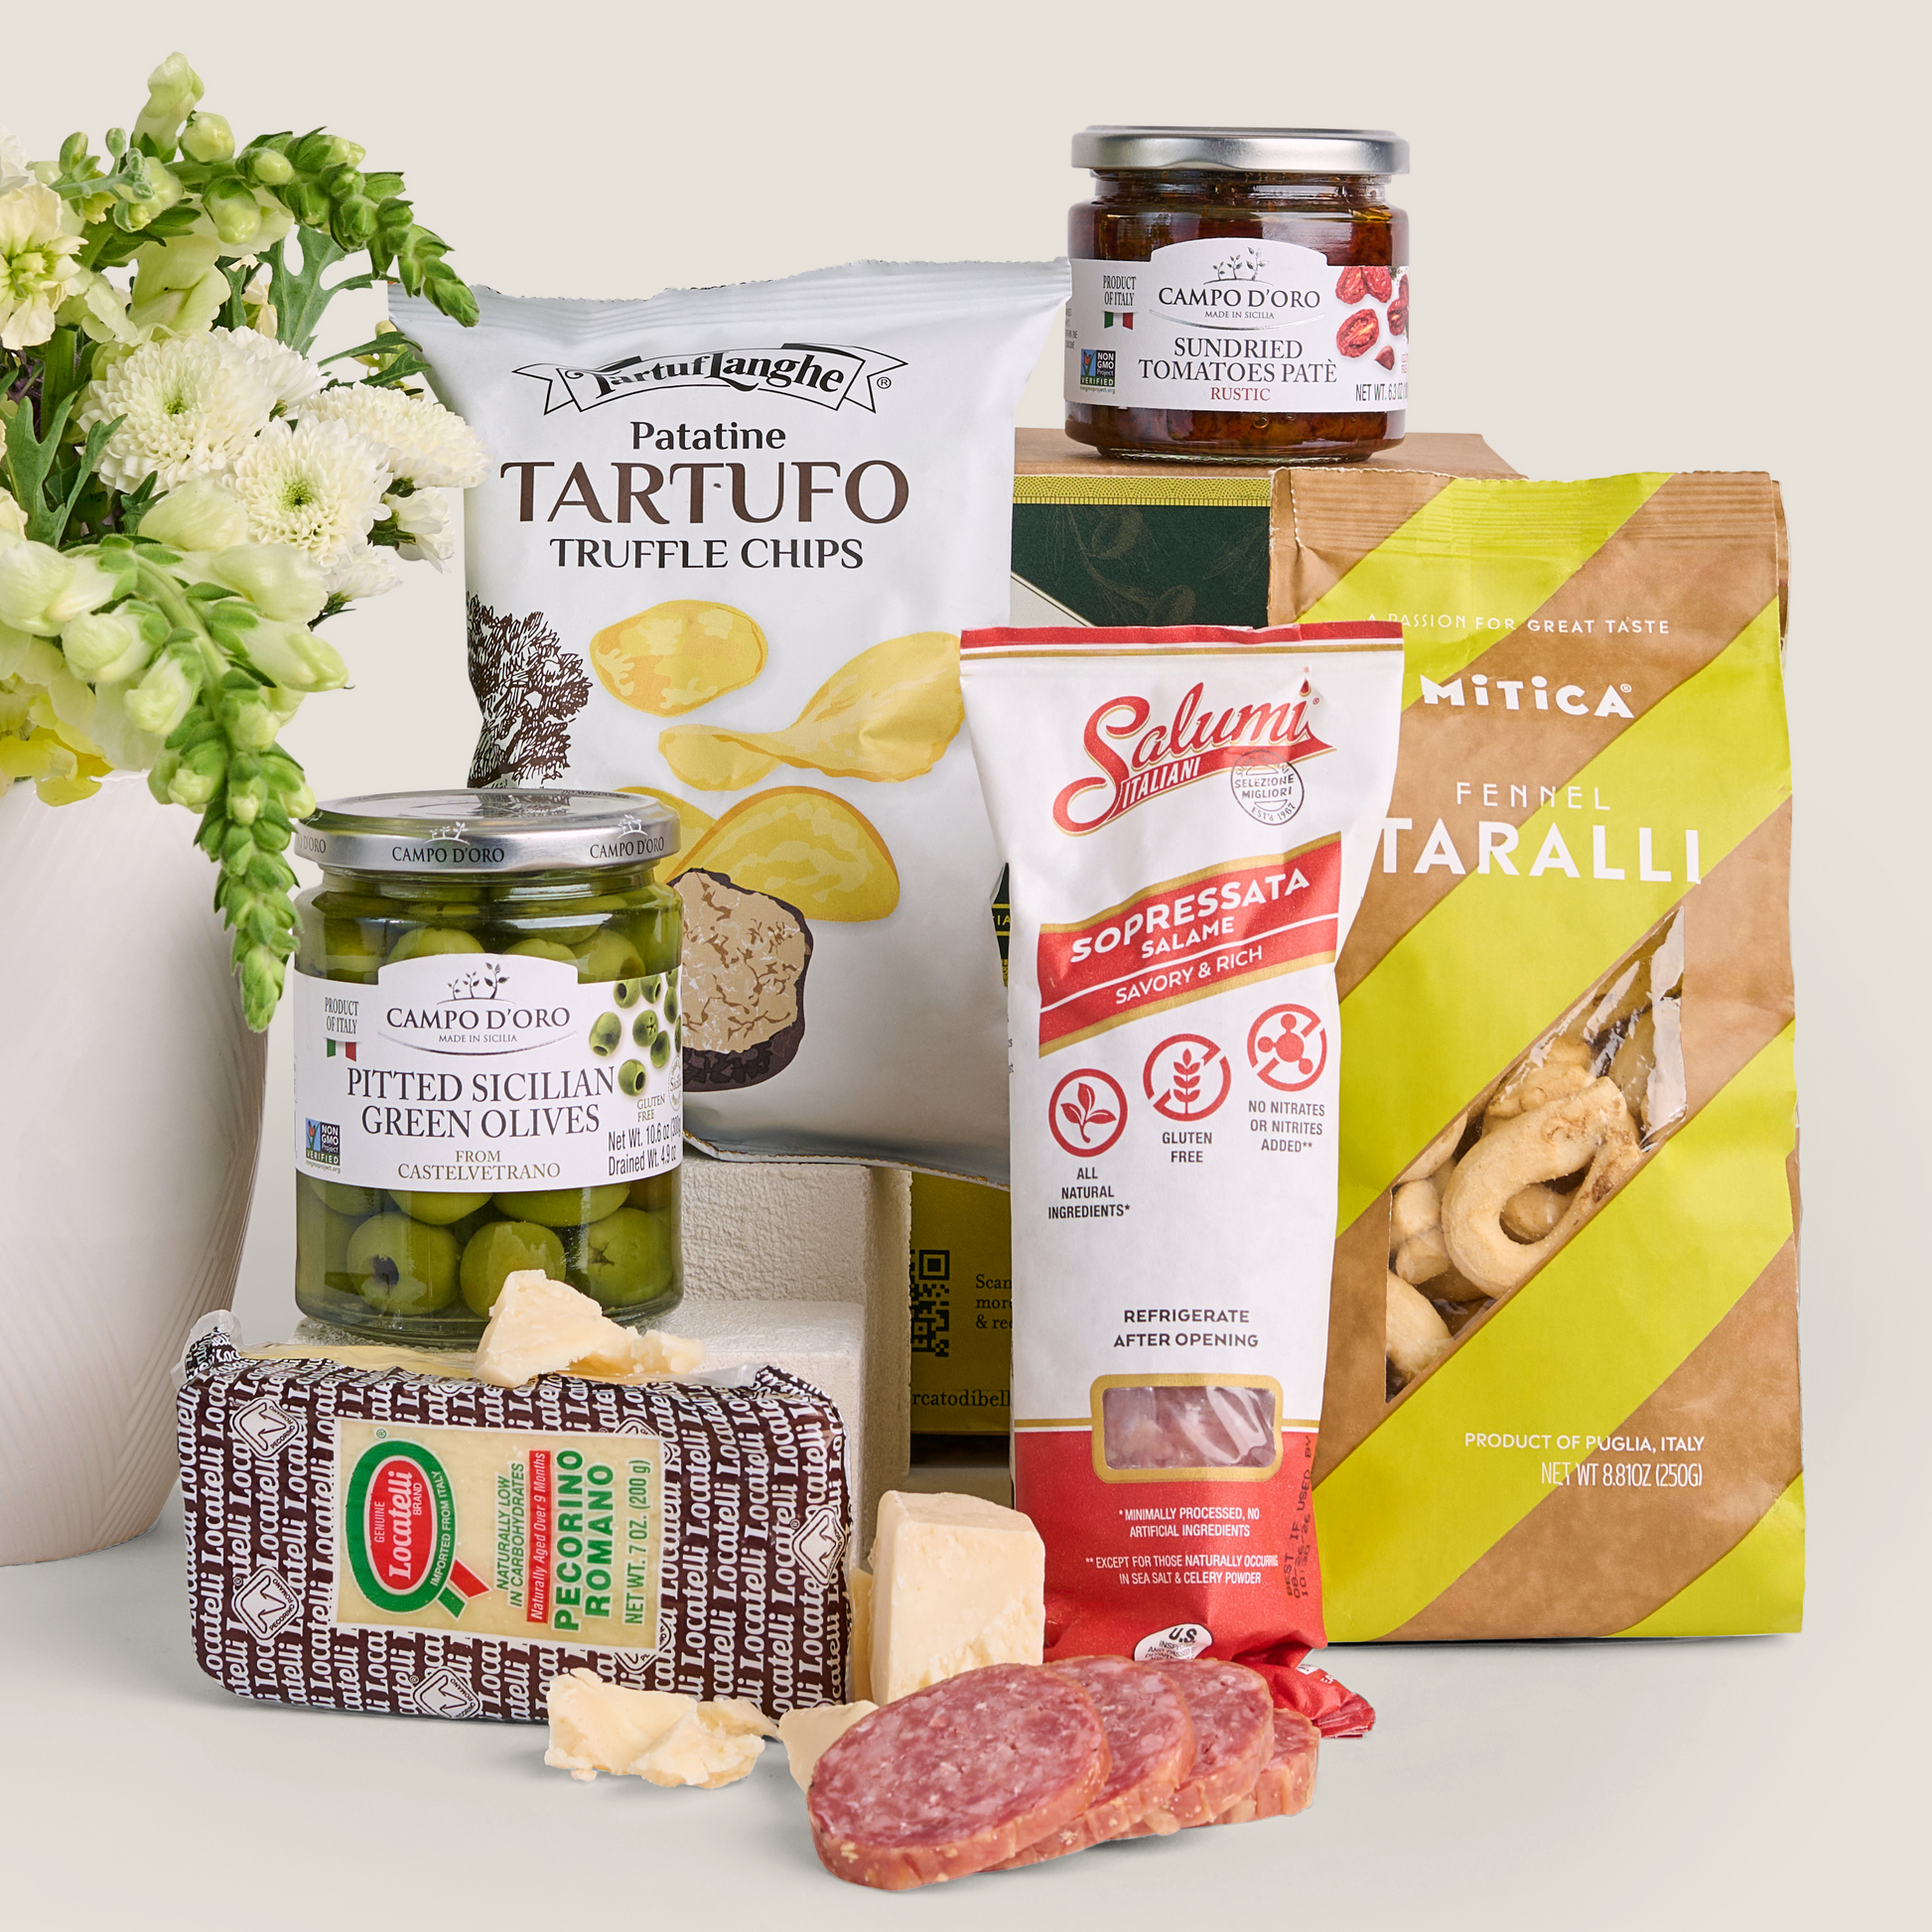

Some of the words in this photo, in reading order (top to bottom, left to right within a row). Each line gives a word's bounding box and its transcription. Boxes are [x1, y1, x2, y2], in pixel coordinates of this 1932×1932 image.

[1103, 275, 1136, 290] PRODUCT
[1104, 292, 1114, 305] OF
[1115, 293, 1134, 306] ITALY
[1159, 287, 1245, 308] CAMPO
[1248, 289, 1320, 309] D'ORO
[1174, 338, 1303, 358] SUNDRIED
[564, 350, 845, 400] TartufLanghe
[1081, 376, 1114, 386] VERIFIED
[1139, 359, 1279, 382] TOMATOES
[1281, 359, 1337, 383] PATÈ
[1210, 387, 1271, 401] RUSTIC
[1356, 383, 1372, 401] NET
[1374, 383, 1387, 401] WT.
[630, 421, 786, 450] Patatine
[499, 460, 909, 525] TARTUFO
[549, 538, 729, 569] TRUFFLE
[741, 537, 864, 570] CHIPS
[1389, 613, 1465, 628] PASSION
[1475, 617, 1517, 630] FOR
[1527, 619, 1595, 634] GREAT
[1605, 620, 1670, 635] TASTE
[1052, 679, 1336, 836] Salumi
[1121, 758, 1201, 809] ITALIANI
[1234, 773, 1295, 788] SELEZIONE
[1242, 786, 1292, 799] MIGLIORI
[1456, 781, 1611, 810] FENNEL
[1277, 802, 1296, 820] 1967
[303, 835, 327, 854] D'ORO
[392, 846, 447, 864] CAMPO
[453, 847, 504, 864] D'ORO
[590, 843, 634, 860] CAMPO
[636, 837, 664, 856] D'ORO
[1382, 817, 1701, 884] TARALLI
[1069, 868, 1310, 964] SOPRESSATA
[1142, 915, 1234, 959] SALAME
[1116, 967, 1193, 1005] SAVORY
[1197, 962, 1211, 977] &
[1217, 945, 1263, 972] RICH
[325, 997, 359, 1017] PRODUCT
[386, 1008, 480, 1031] CAMPO
[485, 1007, 571, 1030] D'ORO
[326, 1015, 337, 1031] OF
[337, 1017, 357, 1035] ITALY
[439, 1035, 466, 1043] MADE
[469, 1035, 480, 1043] IN
[483, 1034, 517, 1043] SICILIA
[347, 1067, 463, 1102] PITTED
[472, 1065, 616, 1103] SICILIAN
[637, 1094, 665, 1110] GLUTEN
[1248, 1100, 1266, 1114] NO
[1270, 1101, 1325, 1117] NITRATES
[361, 1105, 472, 1139] GREEN
[481, 1103, 600, 1139] OLIVES
[637, 1109, 655, 1122] FREE
[1250, 1119, 1267, 1132] OR
[1272, 1120, 1323, 1135] NITRITES
[322, 1124, 339, 1136] NON
[322, 1134, 340, 1146] GMO
[609, 1130, 625, 1152] Net
[628, 1127, 643, 1149] Wt.
[646, 1123, 662, 1145] 10.6
[663, 1124, 670, 1141] oz
[1163, 1132, 1212, 1145] GLUTEN
[307, 1149, 340, 1165] VERIFIED
[455, 1150, 501, 1163] FROM
[609, 1151, 645, 1176] Drained
[647, 1149, 659, 1170] Wt.
[661, 1144, 670, 1165] 4.9
[1171, 1151, 1203, 1163] FREE
[397, 1163, 561, 1181] CASTELVETRANO
[1077, 1168, 1098, 1179] ALL
[1061, 1185, 1114, 1199] NATURAL
[976, 1274, 1012, 1290] Scan
[976, 1314, 988, 1329] &
[1124, 1310, 1250, 1323] REFRIGERATE
[1114, 1332, 1171, 1347] AFTER
[1175, 1332, 1259, 1348] OPENING
[1465, 1433, 1552, 1449] PRODUCT
[1556, 1435, 1581, 1450] OF
[1586, 1436, 1656, 1453] PUGLIA,
[1661, 1436, 1705, 1451] ITALY
[534, 1452, 545, 1491] Months
[628, 1459, 651, 1473] g)
[1542, 1461, 1571, 1486] NET
[1576, 1462, 1598, 1487] WT
[1655, 1463, 1703, 1487] (250G)
[432, 1471, 451, 1498] ITALY
[497, 1475, 510, 1506] LOW
[628, 1478, 650, 1510] (200
[681, 1430, 711, 1539] Locatelli
[738, 1432, 769, 1541] Locatelli
[200, 1445, 224, 1567] Locatelli
[413, 1482, 423, 1516] BRAND
[311, 1457, 335, 1572] Locatelli
[374, 1501, 385, 1543] GENUINE
[388, 1470, 412, 1580] Locatelli
[442, 1501, 451, 1531] FROM
[511, 1462, 524, 1587] CARBOHYDRATES
[534, 1505, 546, 1530] Over
[1179, 1507, 1245, 1522] PROCESSED,
[1247, 1507, 1260, 1520] NO
[1284, 1552, 1295, 1597] BEST
[1291, 1521, 1301, 1541] IF
[1297, 1469, 1311, 1511] USED
[1305, 1435, 1311, 1458] BY
[628, 1515, 647, 1540] OZ.
[1130, 1525, 1179, 1538] ARTIFICIAL
[1181, 1524, 1251, 1537] INGREDIENTS
[496, 1510, 510, 1590] NATURALLY
[533, 1534, 548, 1564] Aged
[554, 1450, 583, 1630] PECORINO
[585, 1464, 614, 1616] ROMANO
[628, 1544, 646, 1555] 7
[713, 1482, 741, 1602] Locatelli
[430, 1535, 451, 1587] IMPORTED
[1133, 1556, 1152, 1568] FOR
[1153, 1555, 1182, 1567] THOSE
[1184, 1554, 1242, 1567] NATURALLY
[626, 1561, 645, 1588] WT.
[1119, 1573, 1130, 1585] IN
[1131, 1573, 1150, 1585] SEA
[1152, 1573, 1173, 1585] SALT
[1174, 1573, 1181, 1584] &
[1183, 1572, 1223, 1585] CELERY
[1225, 1572, 1261, 1585] POWDER
[273, 1579, 294, 1603] ROMANO
[510, 1590, 522, 1606] IN
[531, 1566, 547, 1619] Naturally
[269, 1604, 295, 1630] PECORINO
[625, 1592, 643, 1624] NET
[681, 1545, 709, 1669] Locatelli
[740, 1547, 767, 1672] Locatelli
[307, 1580, 334, 1691] Locatelli
